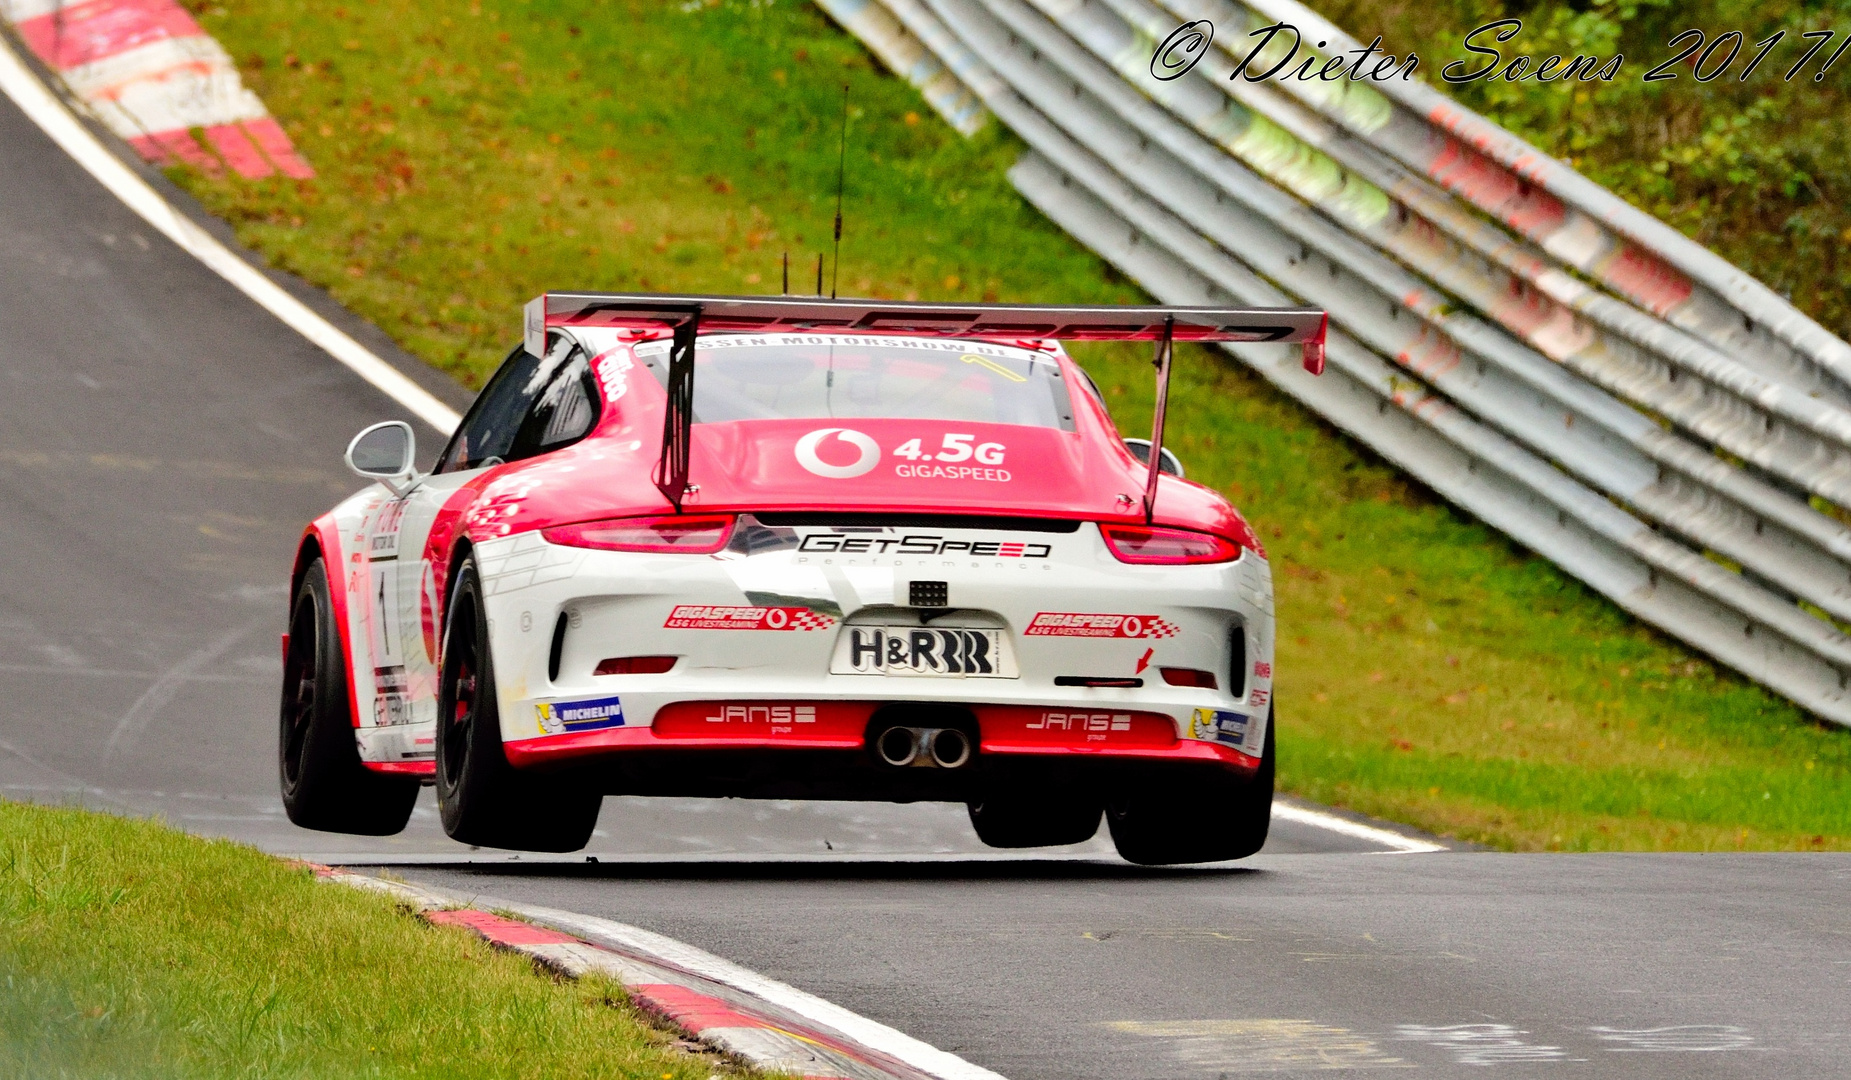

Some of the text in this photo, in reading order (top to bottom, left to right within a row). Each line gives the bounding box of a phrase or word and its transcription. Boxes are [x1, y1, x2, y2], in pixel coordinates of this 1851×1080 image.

[893, 433, 1007, 465] 4.5G
[895, 464, 1012, 482] GIGASPEED
[798, 557, 1052, 571] Performance
[672, 606, 768, 621] GIGASPEED
[1033, 613, 1125, 629] GIGASPEED
[689, 619, 760, 629] LIVESTREAMING
[1051, 626, 1117, 637] LIVESTREAMING
[562, 704, 620, 720] MICHELIN
